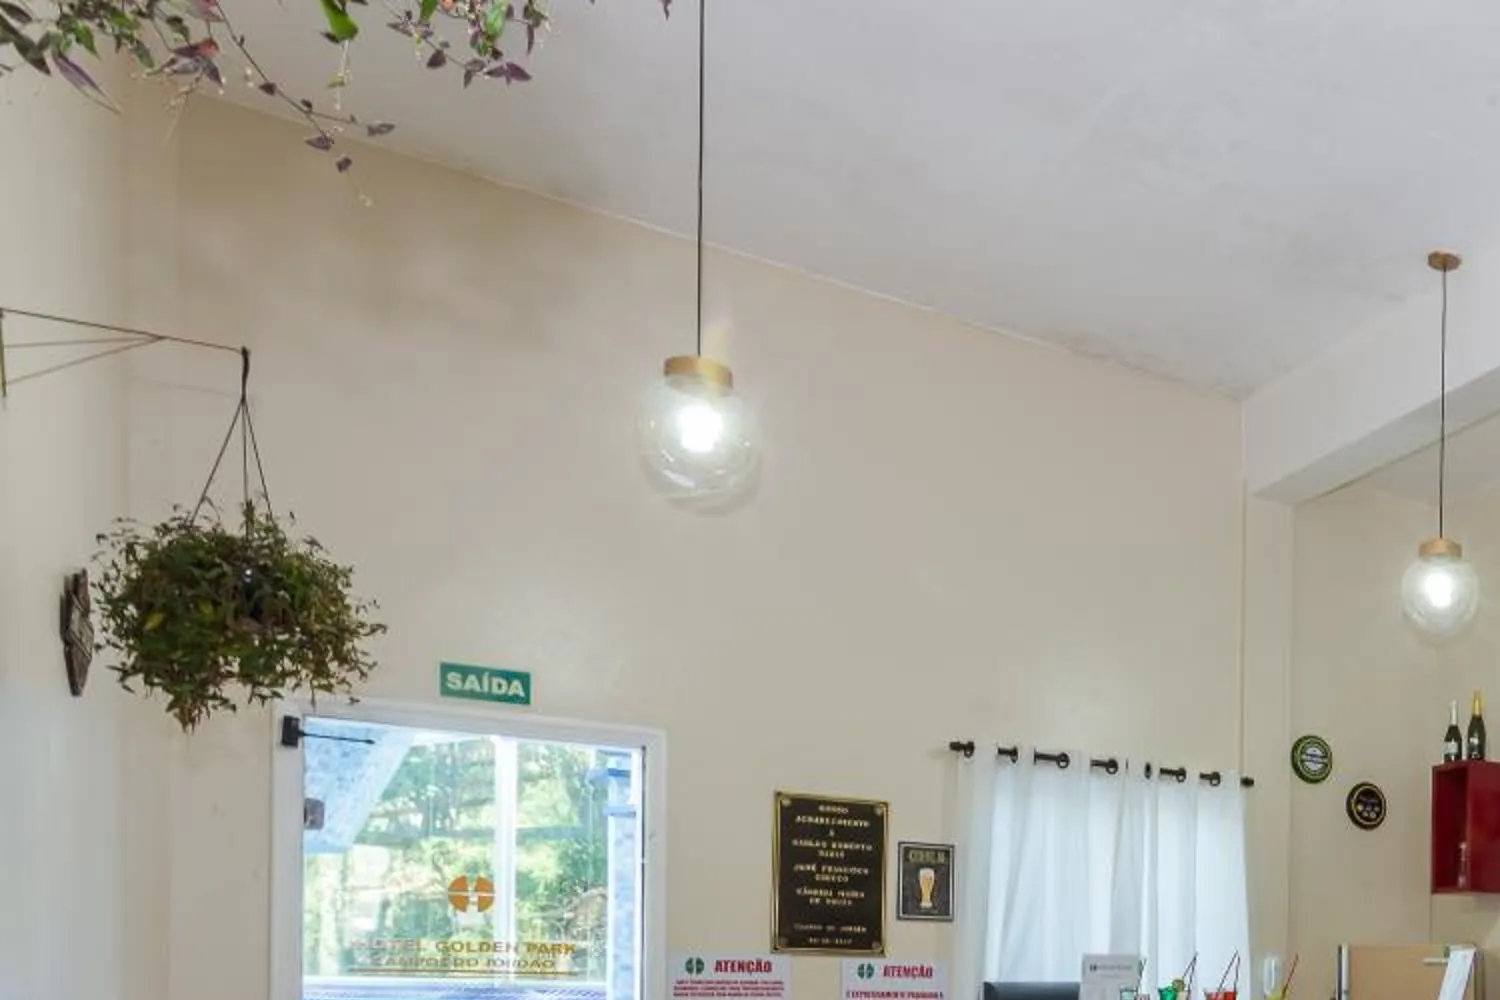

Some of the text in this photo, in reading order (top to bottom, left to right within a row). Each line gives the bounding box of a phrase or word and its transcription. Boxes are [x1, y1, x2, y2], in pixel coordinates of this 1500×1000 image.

[447, 671, 525, 697] SAÍDA
[435, 940, 519, 955] GOLDEN
[526, 942, 577, 956] PARK
[715, 957, 772, 976] ATENÇÃO
[883, 963, 933, 981] ATENÇÃO
